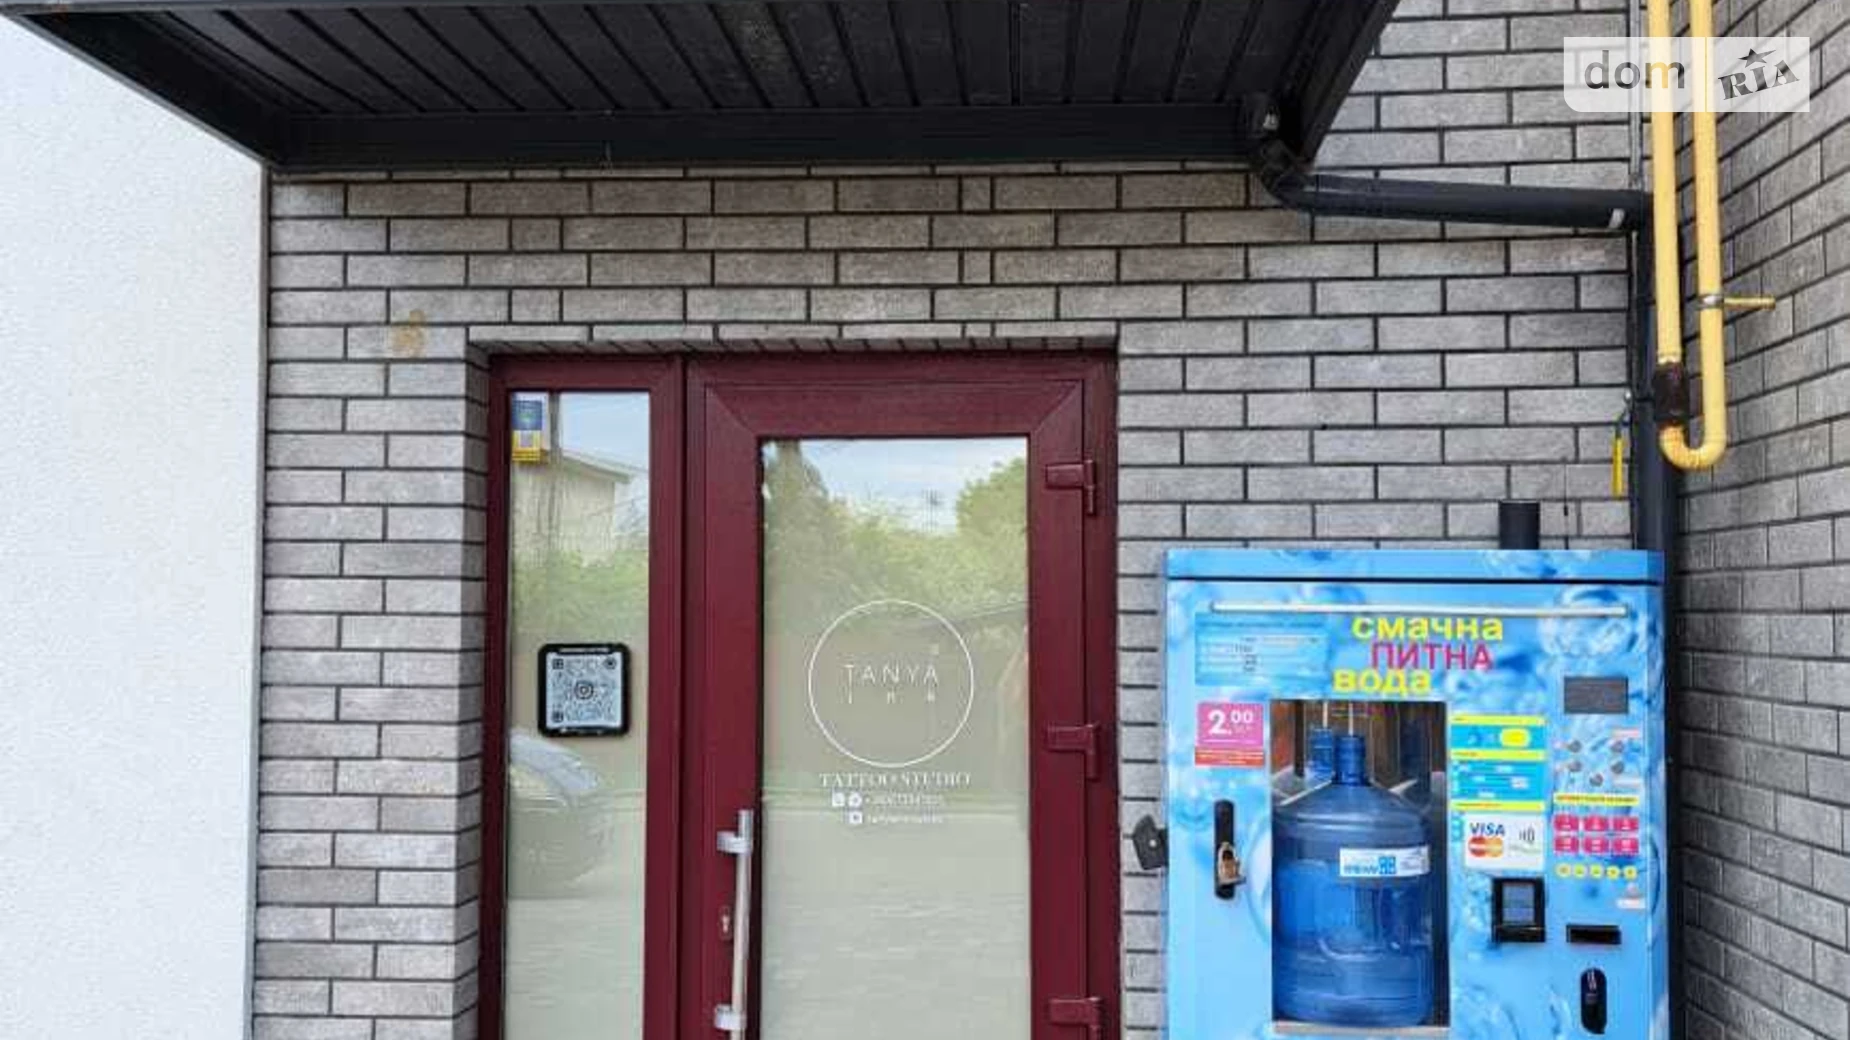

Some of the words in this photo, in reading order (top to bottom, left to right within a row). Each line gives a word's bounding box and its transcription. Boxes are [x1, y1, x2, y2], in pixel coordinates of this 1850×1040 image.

[1351, 615, 1504, 641] смачна
[1371, 642, 1493, 670] ПИТНА
[845, 664, 939, 685] TANYA
[1332, 669, 1431, 695] вода
[1469, 822, 1506, 836] VISA
